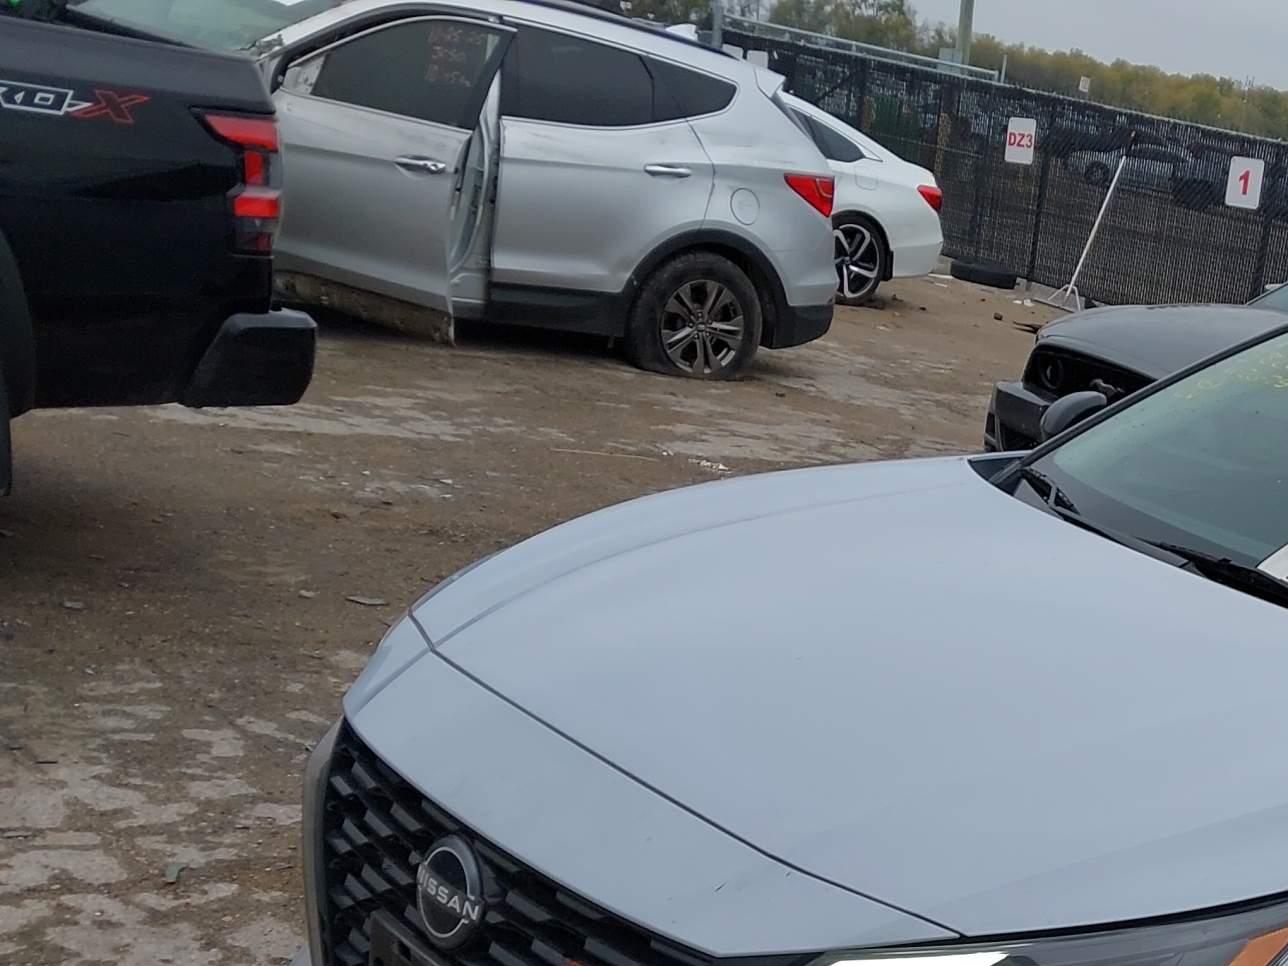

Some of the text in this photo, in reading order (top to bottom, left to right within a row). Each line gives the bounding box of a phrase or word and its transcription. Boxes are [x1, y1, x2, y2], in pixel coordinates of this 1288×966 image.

[1008, 132, 1033, 149] DZ3
[1238, 169, 1250, 196] 1
[416, 864, 480, 921] NISSAN
